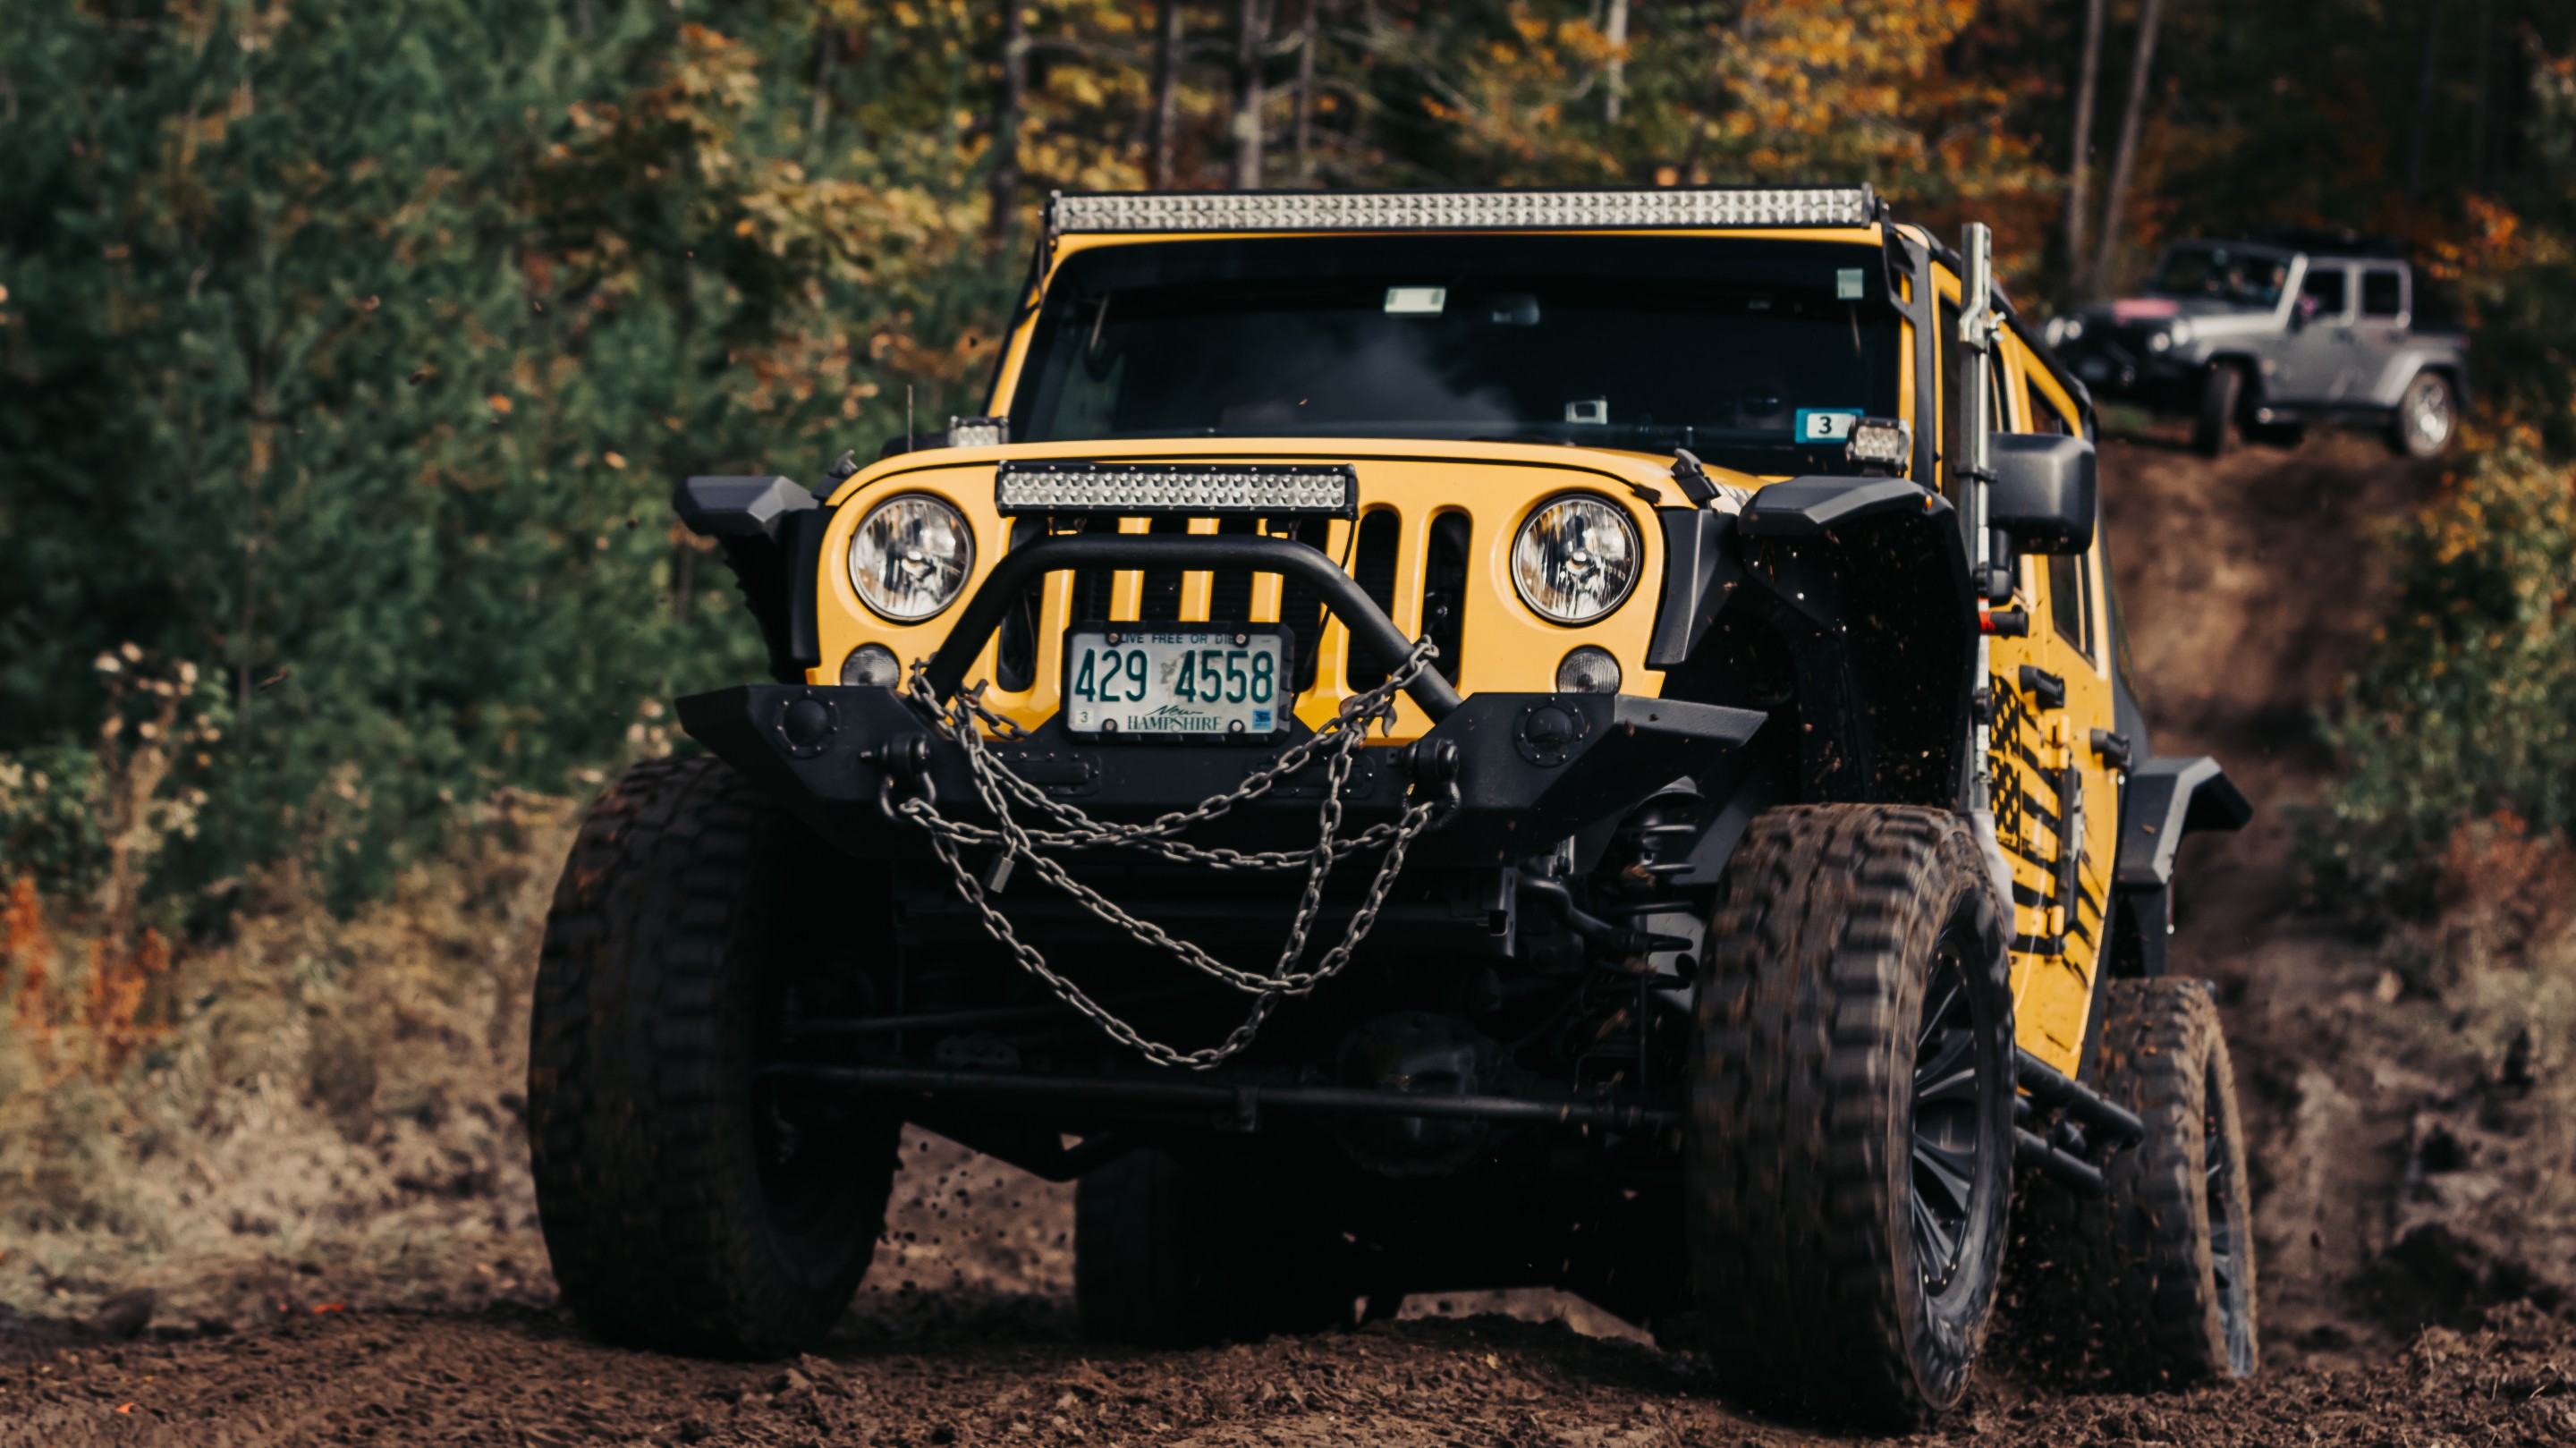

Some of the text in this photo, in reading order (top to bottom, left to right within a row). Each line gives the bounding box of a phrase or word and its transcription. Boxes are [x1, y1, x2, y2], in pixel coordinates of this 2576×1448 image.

[1818, 416, 1833, 435] 3
[1121, 634, 1234, 645] LIVE FREE OR DIE
[1074, 648, 1275, 704] 429 4558
[1080, 710, 1089, 724] 3
[1145, 704, 1204, 716] New
[1127, 716, 1223, 732] HAMPSHIRE
